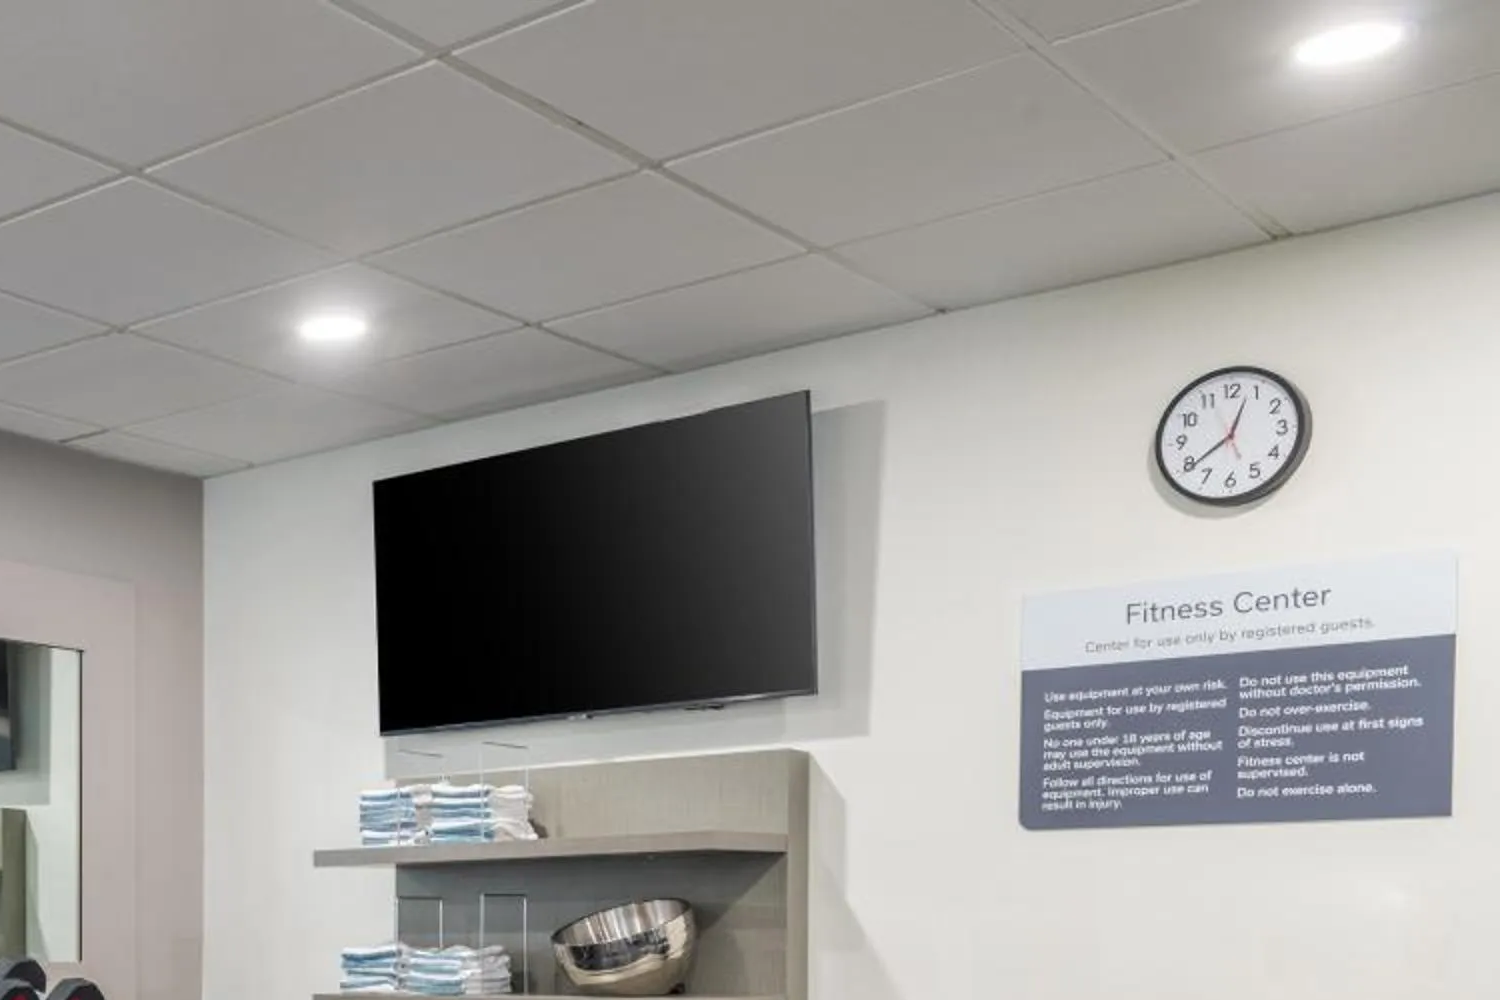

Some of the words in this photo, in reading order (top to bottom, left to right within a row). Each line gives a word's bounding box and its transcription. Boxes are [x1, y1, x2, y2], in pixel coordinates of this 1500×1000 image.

[1223, 384, 1241, 399] 12
[1254, 385, 1259, 400] 1
[1201, 393, 1215, 409] 11
[1269, 398, 1281, 414] 2
[1182, 411, 1198, 428] 10
[1276, 419, 1289, 436] 3
[1175, 434, 1188, 450] 9
[1268, 444, 1279, 460] 4
[1183, 455, 1195, 472] 8
[1249, 462, 1261, 478] 5
[1202, 467, 1213, 484] 7
[1224, 471, 1237, 488] 6
[1126, 600, 1224, 625] Fitness
[1233, 587, 1332, 614] Center
[1085, 639, 1129, 653] Center
[1134, 637, 1152, 649] for
[1157, 636, 1180, 647] use
[1185, 630, 1214, 644] only
[1219, 629, 1236, 643] by
[1241, 622, 1315, 640] registered
[1239, 676, 1258, 688] Do
[1261, 674, 1282, 687] not
[1284, 674, 1308, 685] use
[1311, 671, 1335, 683] this
[1337, 664, 1409, 681] equipment
[1044, 692, 1066, 702] Use
[1068, 687, 1128, 701] equipment
[1131, 686, 1143, 696] at
[1145, 684, 1172, 697] your
[1174, 683, 1200, 693] own
[1239, 687, 1287, 699] without
[1044, 707, 1104, 720] Equipment
[1107, 705, 1122, 716] for
[1125, 705, 1147, 715] use
[1149, 702, 1164, 715] by
[1165, 698, 1227, 713] registered
[1239, 706, 1257, 718] Do
[1260, 705, 1281, 717] not
[1044, 720, 1081, 732] guests
[1238, 722, 1314, 737] Discontinue
[1315, 722, 1339, 733] use
[1341, 720, 1355, 731] at
[1358, 717, 1384, 730] first
[1387, 716, 1423, 729] signs
